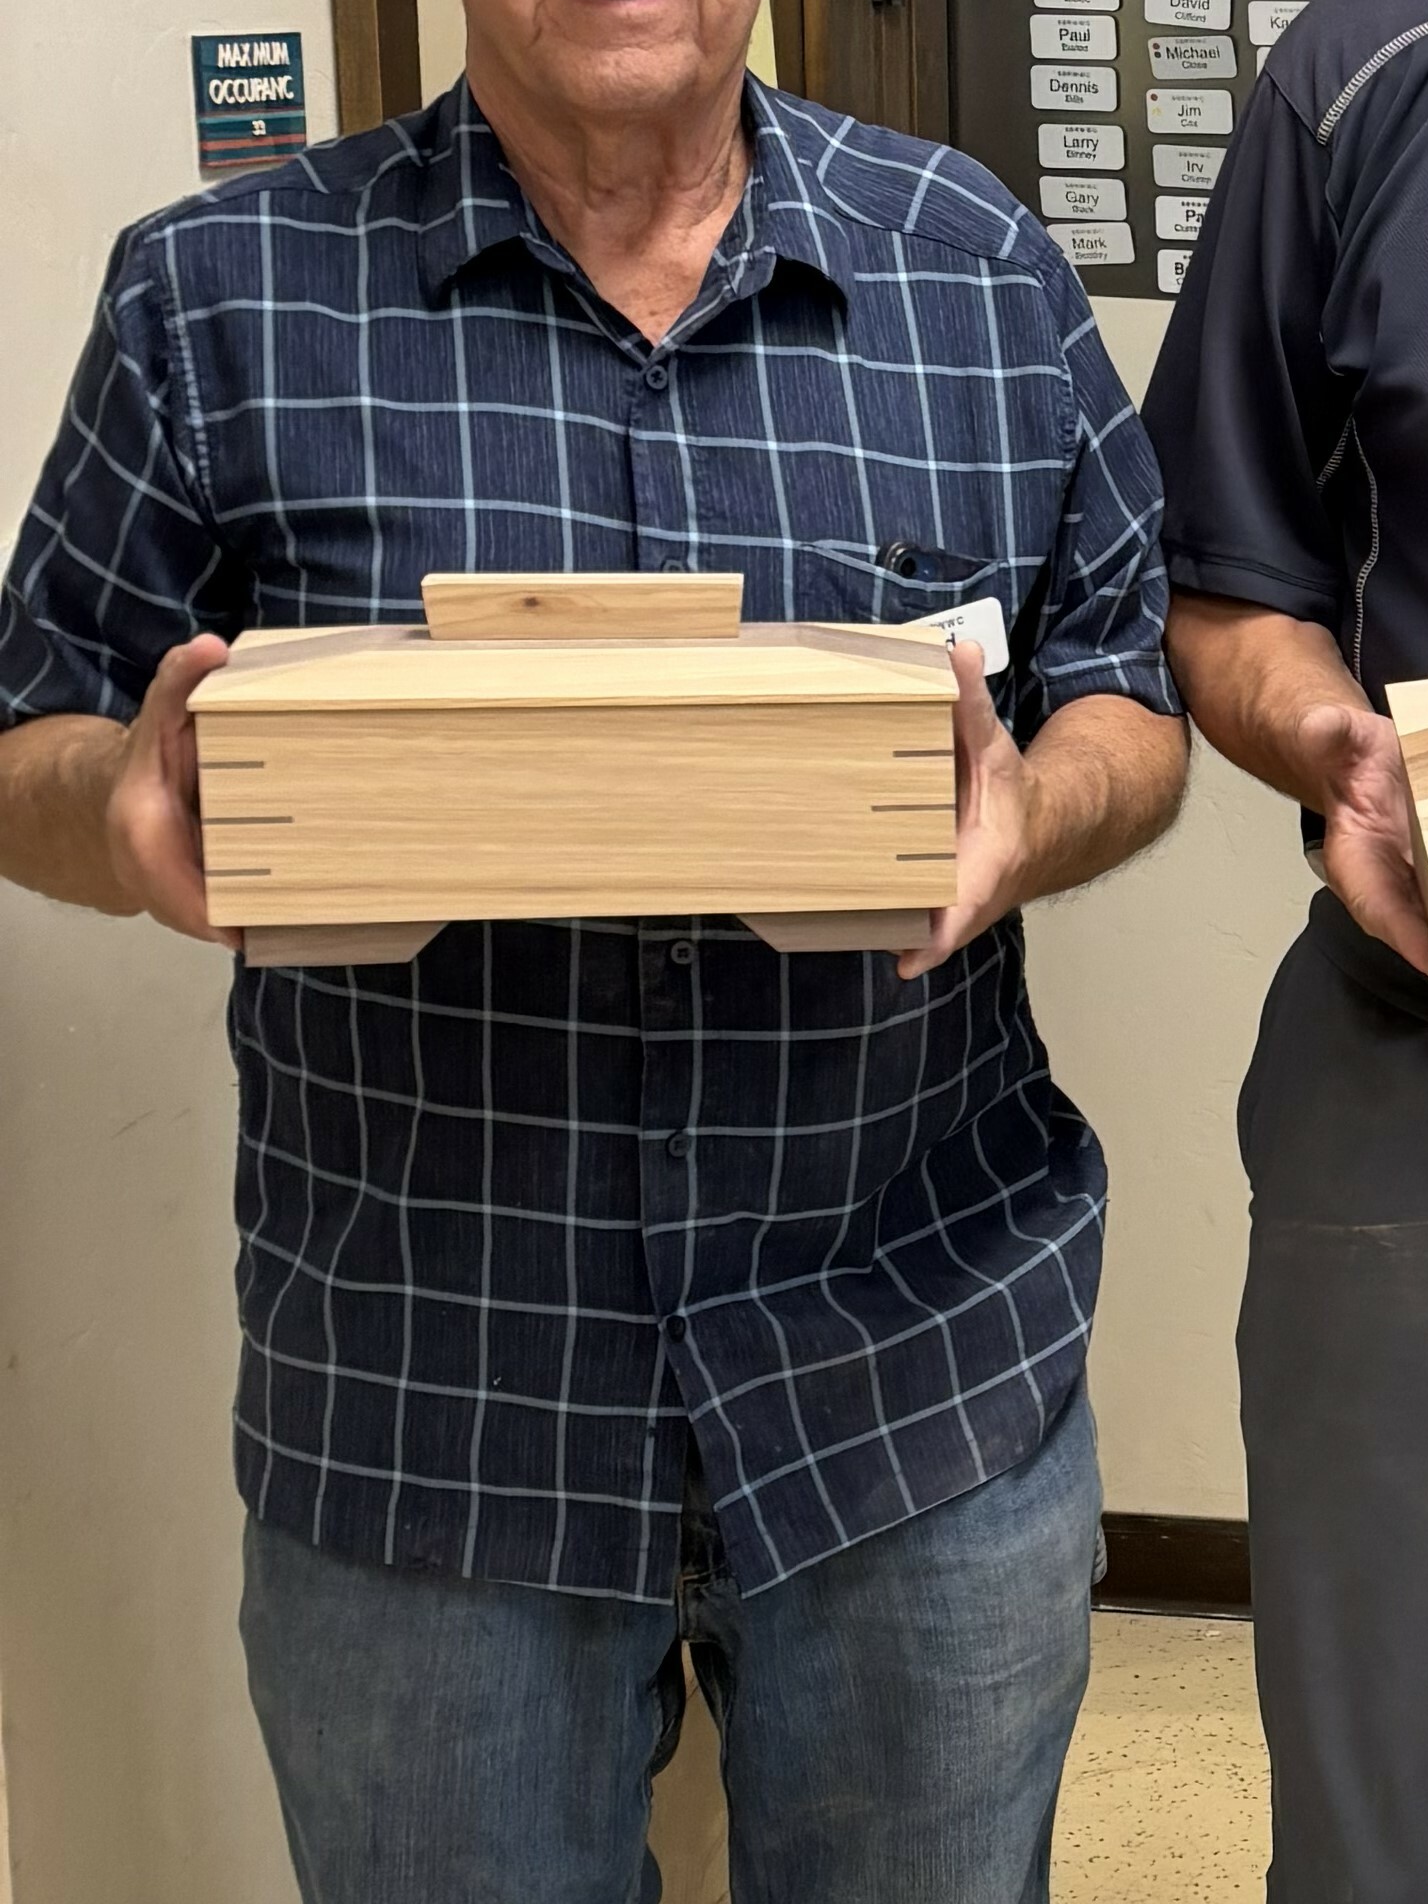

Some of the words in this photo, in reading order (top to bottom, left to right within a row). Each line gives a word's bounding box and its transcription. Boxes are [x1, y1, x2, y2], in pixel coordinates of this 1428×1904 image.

[1058, 28, 1091, 42] Paul
[1166, 46, 1220, 60] Michael
[1050, 79, 1099, 94] Dennis
[1177, 105, 1202, 118] Jim
[1063, 136, 1099, 152] Larry
[1186, 160, 1204, 173] Irv
[1065, 191, 1099, 207] Gary
[1072, 237, 1107, 250] Mark
